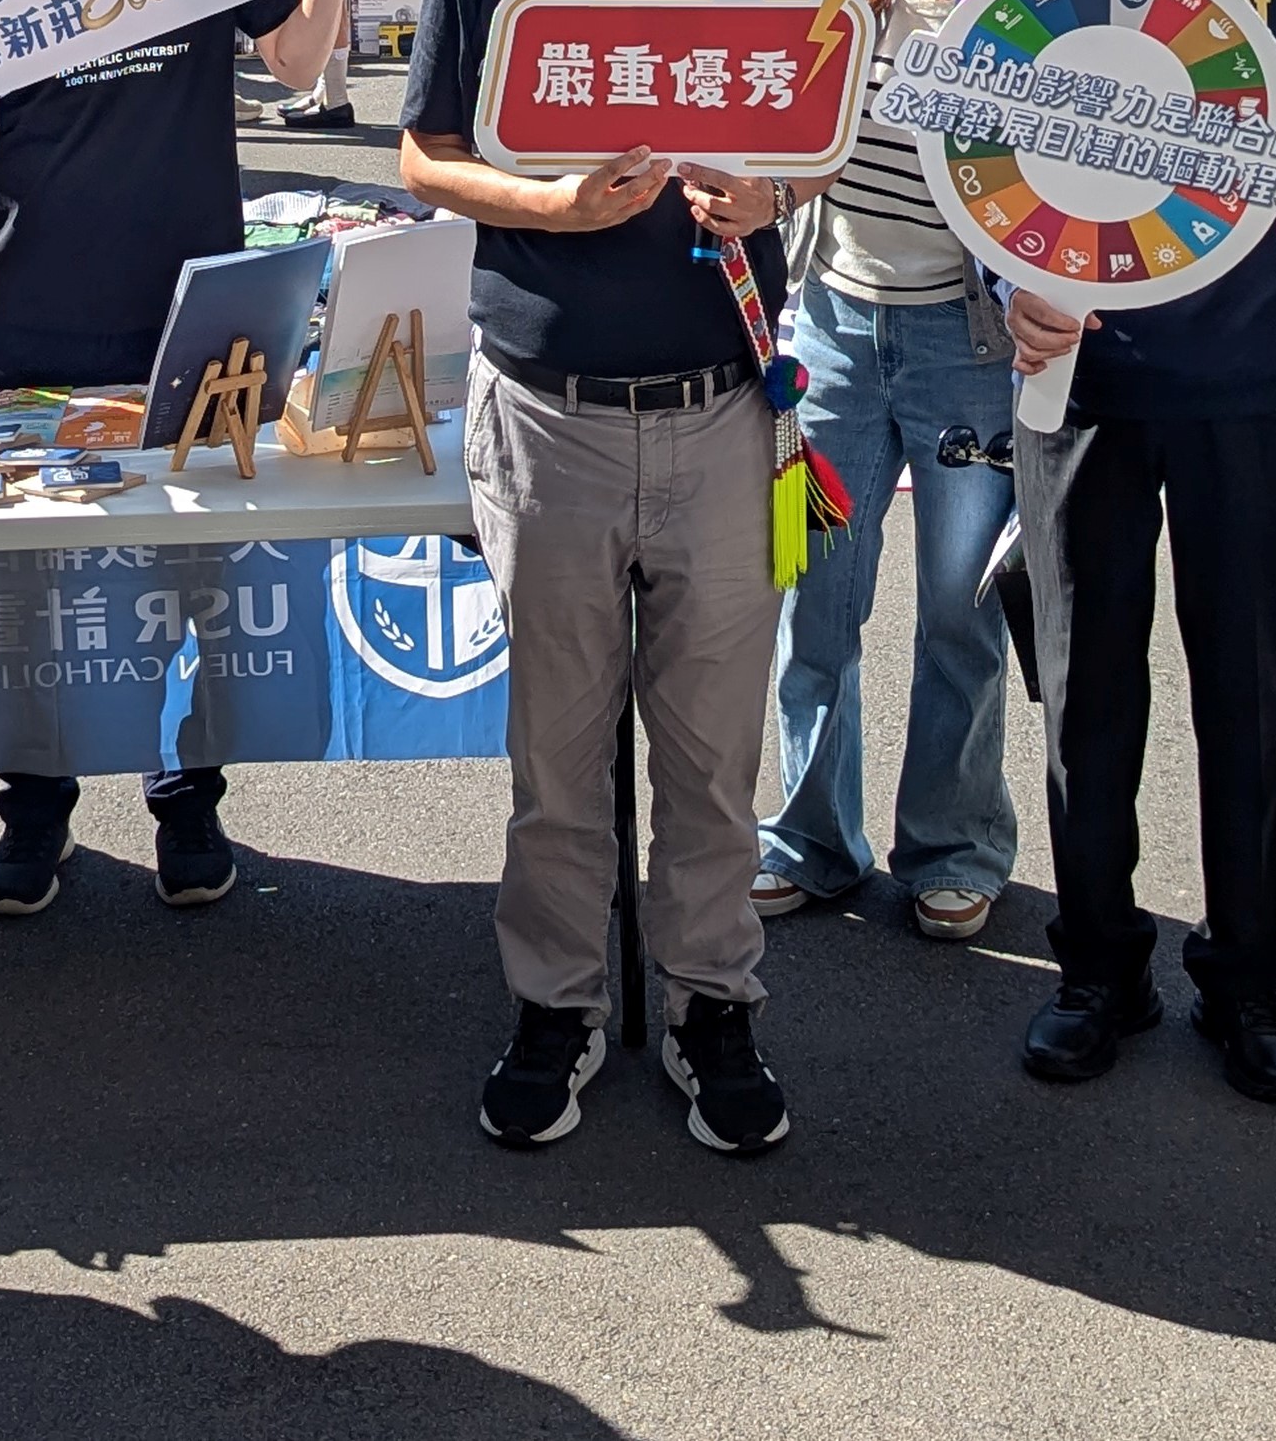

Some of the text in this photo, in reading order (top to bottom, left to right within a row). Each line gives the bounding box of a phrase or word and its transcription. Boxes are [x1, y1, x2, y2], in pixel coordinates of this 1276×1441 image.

[126, 42, 190, 60] UNIVERSITY
[65, 74, 97, 87] 100TH
[532, 42, 798, 110] 嚴重優秀
